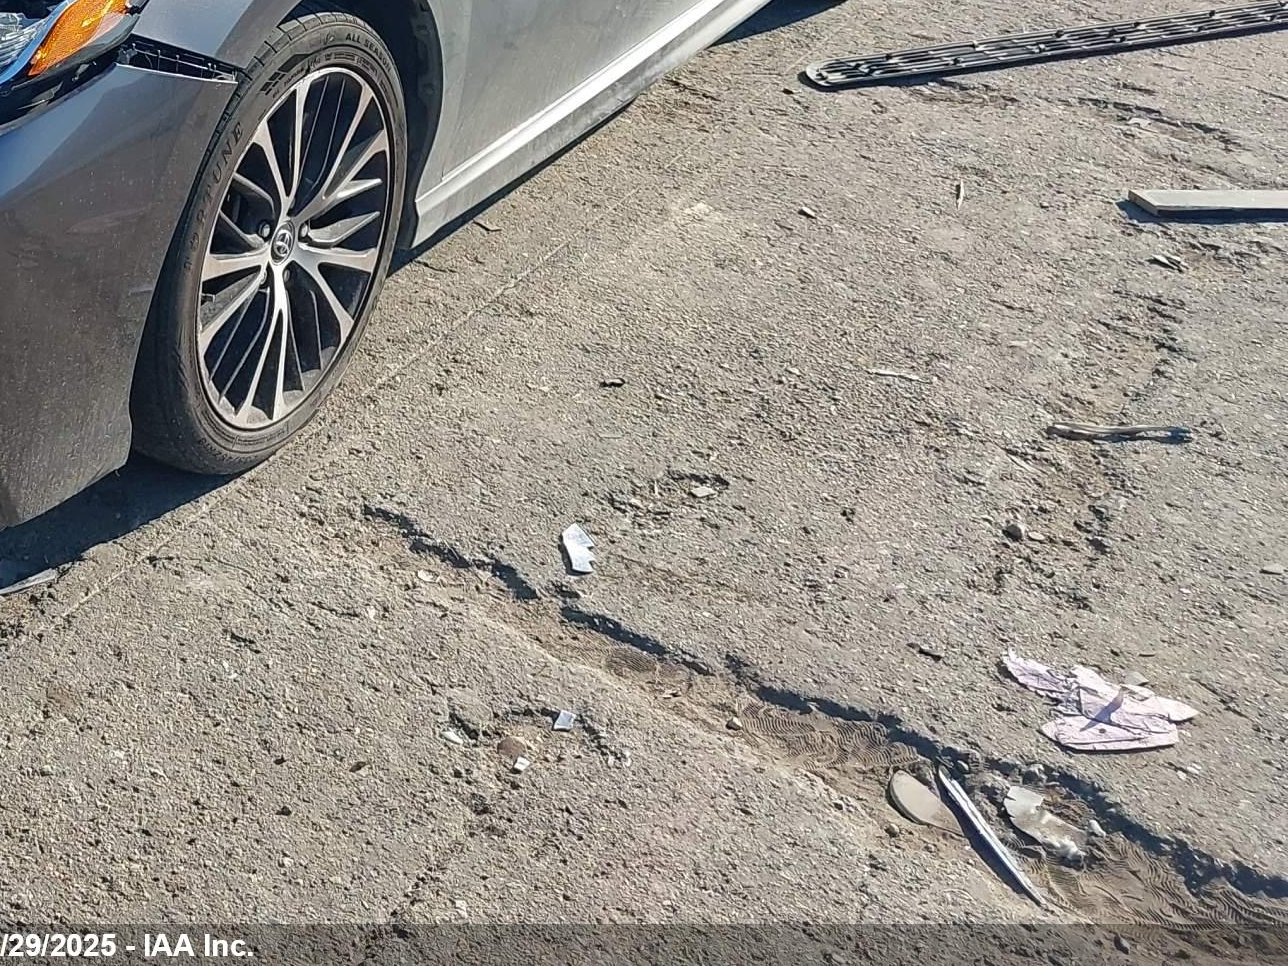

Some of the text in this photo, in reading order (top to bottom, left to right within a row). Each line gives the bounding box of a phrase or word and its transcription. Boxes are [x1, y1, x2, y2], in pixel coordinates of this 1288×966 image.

[345, 33, 361, 44] ALL
[363, 39, 392, 73] SEASON
[184, 121, 243, 271] FORTUNE
